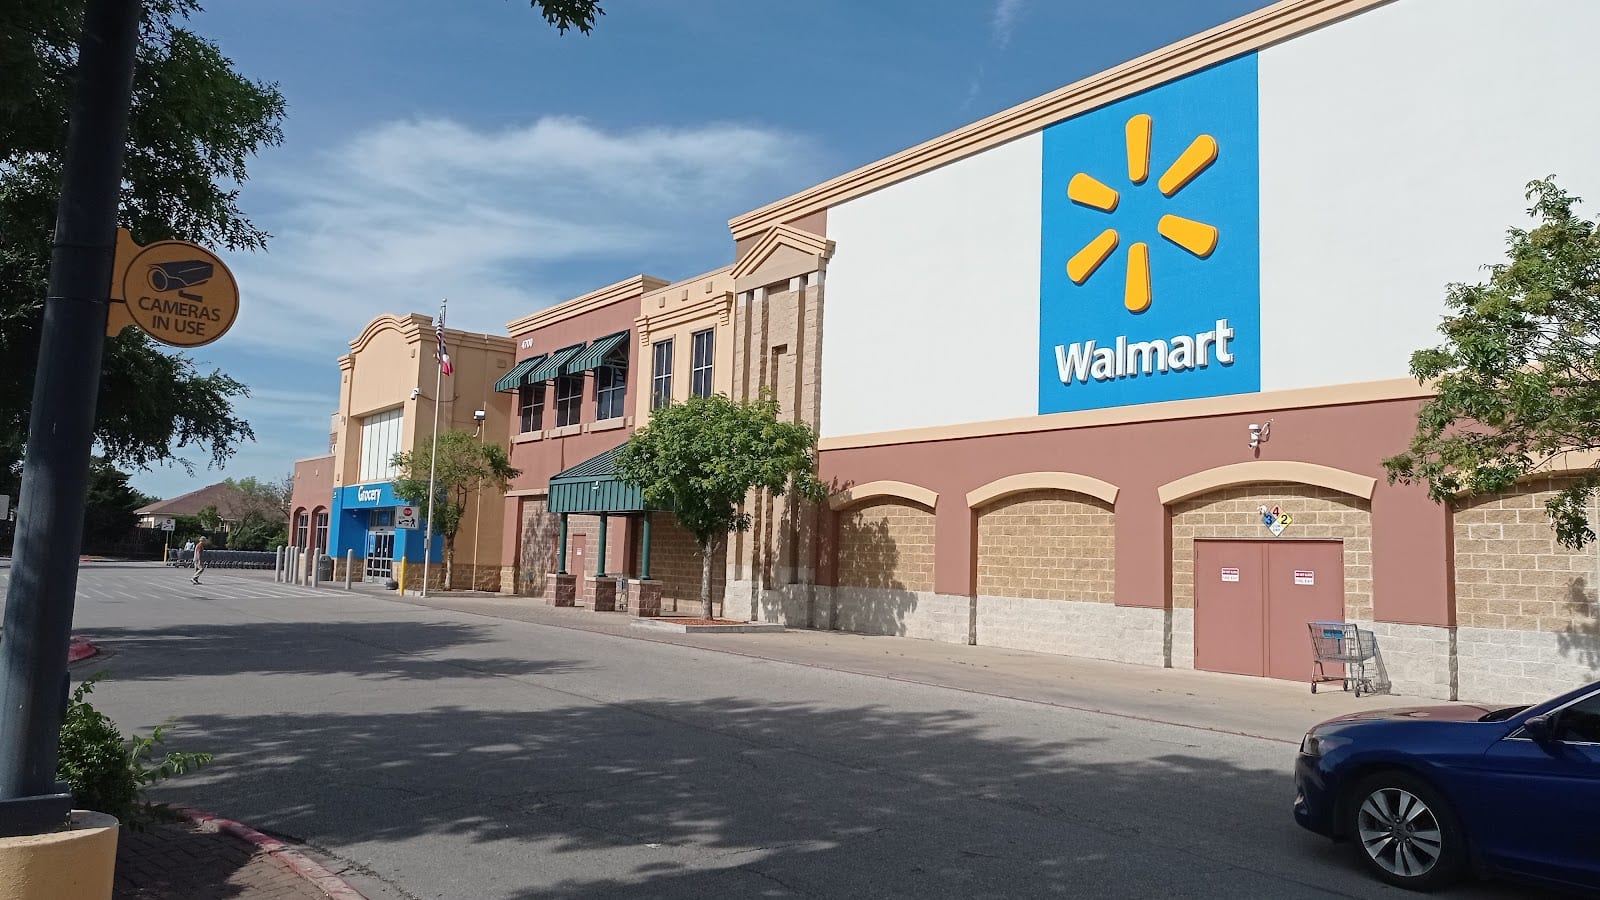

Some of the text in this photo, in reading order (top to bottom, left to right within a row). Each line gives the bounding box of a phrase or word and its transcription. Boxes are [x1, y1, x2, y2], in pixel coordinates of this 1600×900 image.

[138, 296, 221, 322] CAMERAS
[152, 315, 206, 336] IN USE
[1054, 318, 1235, 384] Walmart
[358, 486, 382, 505] Grocery
[1265, 514, 1273, 525] 3
[1272, 506, 1280, 517] 4
[1280, 514, 1288, 525] 2
